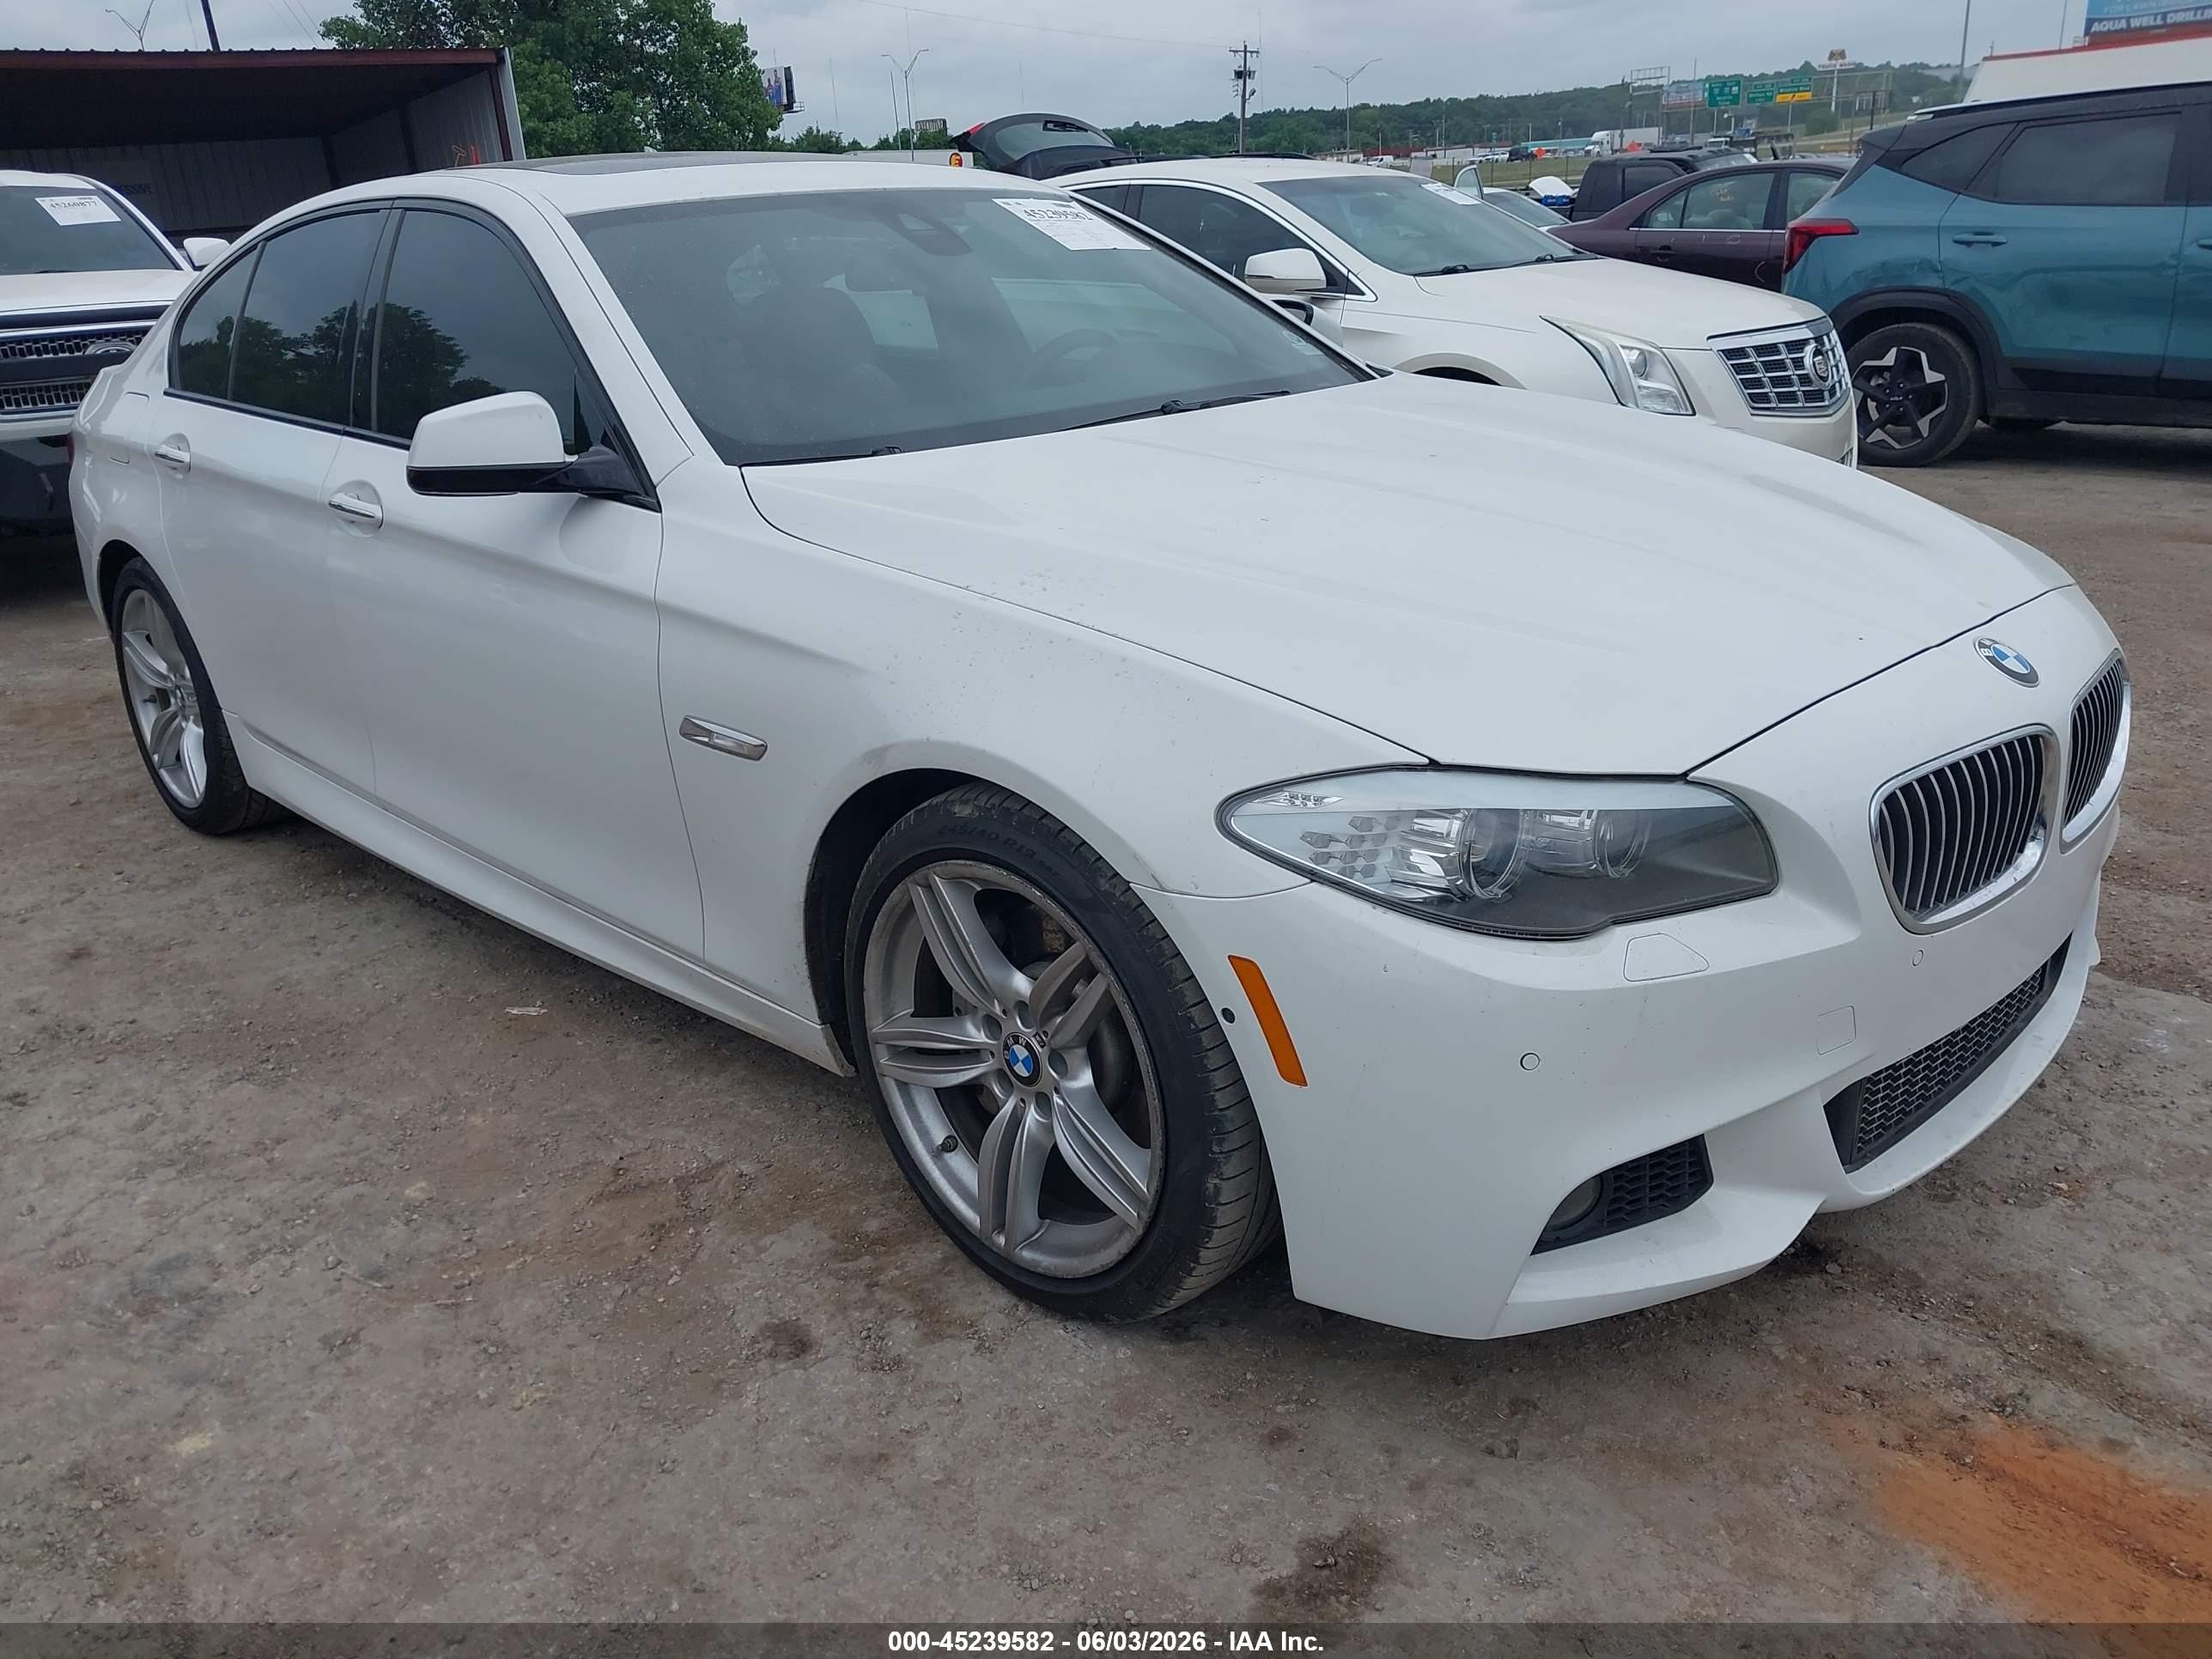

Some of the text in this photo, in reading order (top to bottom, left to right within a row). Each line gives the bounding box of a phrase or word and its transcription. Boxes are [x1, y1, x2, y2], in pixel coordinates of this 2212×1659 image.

[2091, 19, 2127, 33] AQUA
[2130, 14, 2164, 28] WELL
[1023, 209, 1093, 221] 45239582
[1002, 837, 1037, 860] R19
